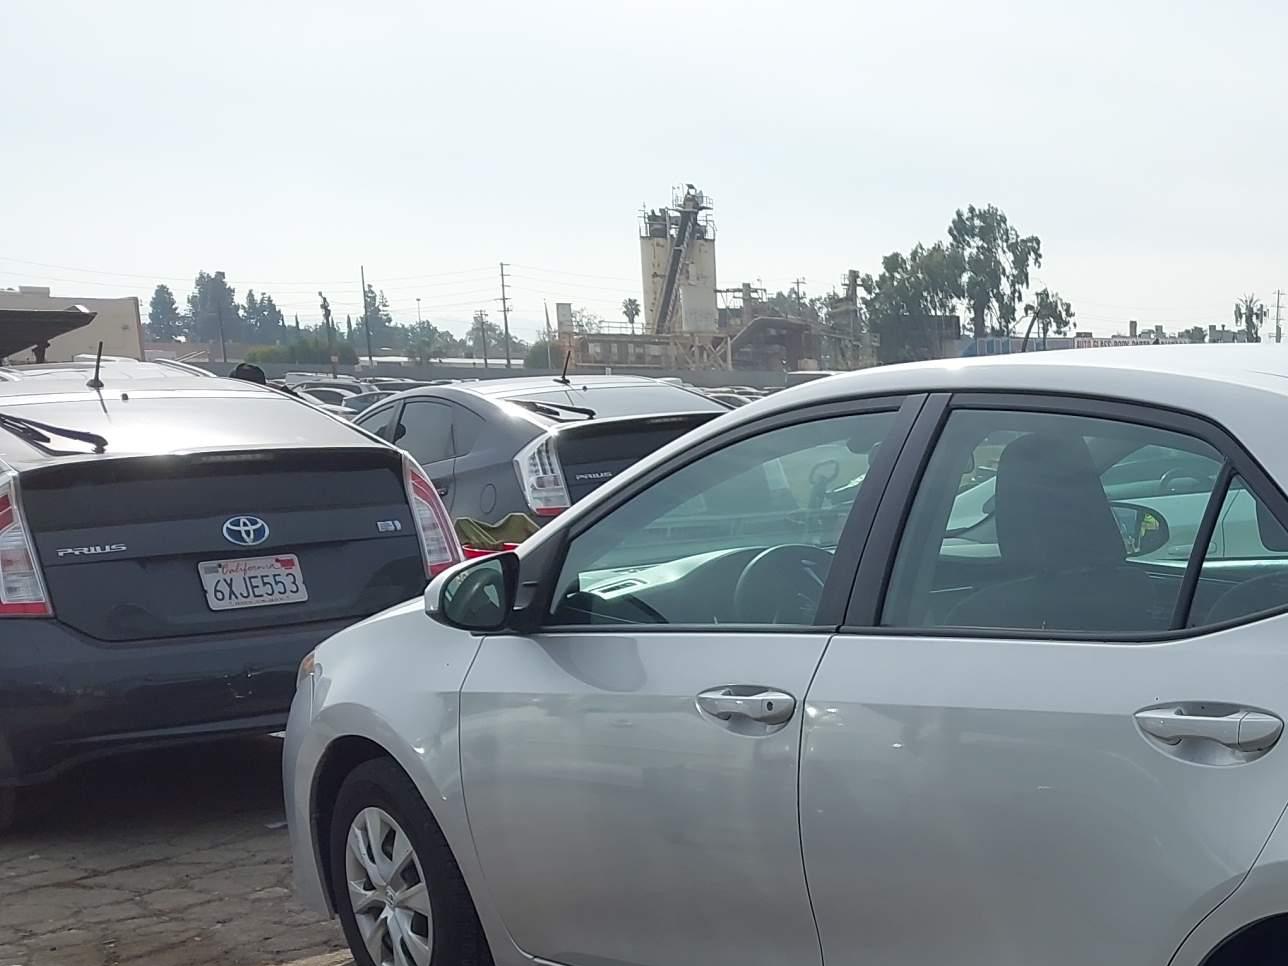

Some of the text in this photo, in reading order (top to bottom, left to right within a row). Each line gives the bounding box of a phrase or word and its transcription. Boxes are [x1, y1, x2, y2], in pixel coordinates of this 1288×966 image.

[576, 471, 613, 480] PRIUS
[56, 543, 127, 557] PRIUS
[222, 562, 280, 576] California
[213, 573, 299, 602] 6XJE553
